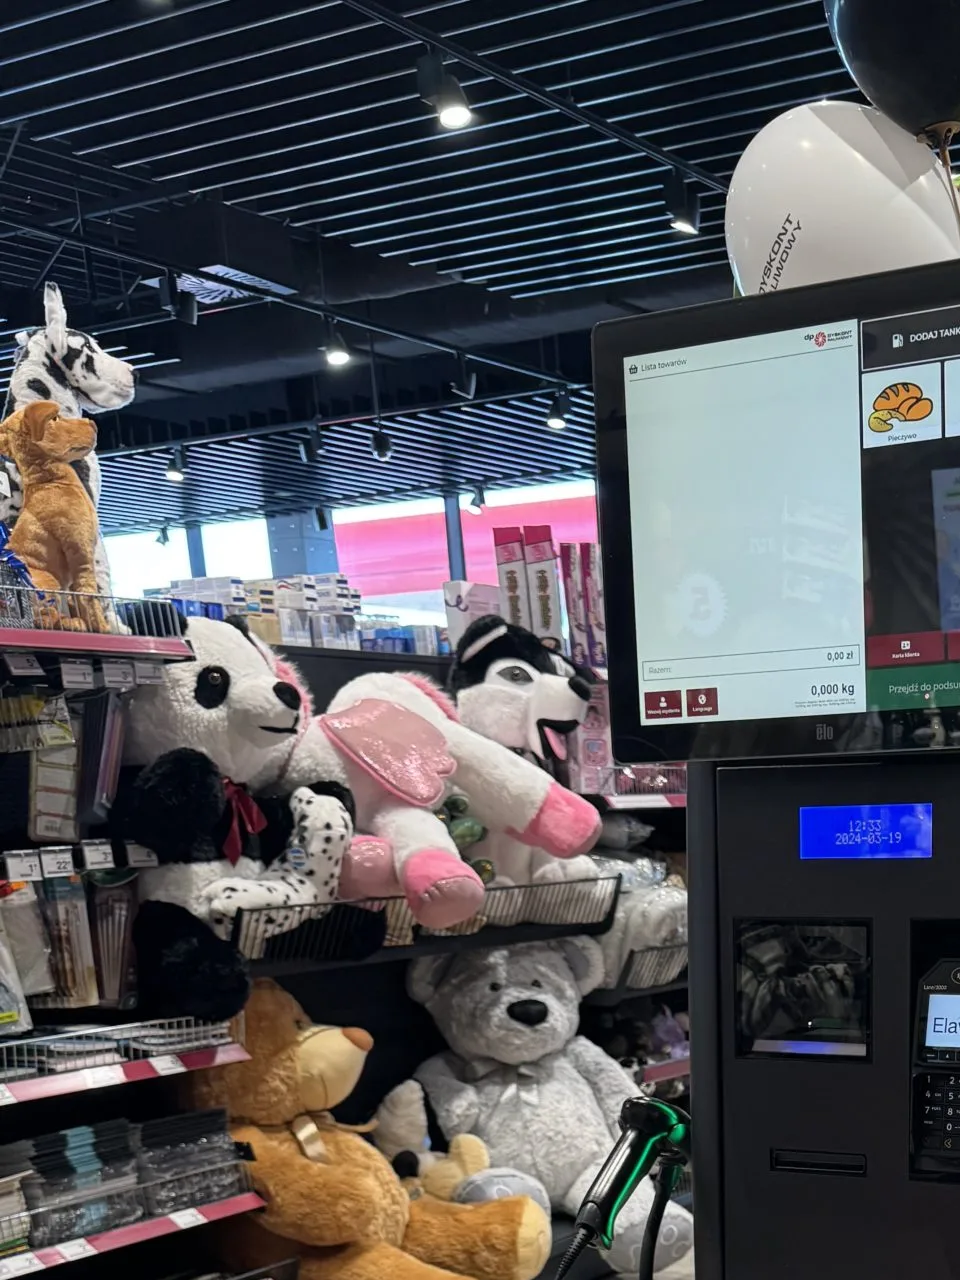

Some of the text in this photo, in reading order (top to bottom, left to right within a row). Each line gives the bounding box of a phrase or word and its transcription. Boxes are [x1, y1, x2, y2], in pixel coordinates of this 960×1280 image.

[770, 219, 802, 291] LIWOWY
[909, 330, 938, 343] DODAJ
[641, 359, 688, 372] Lista towarów
[887, 432, 918, 443] Pieczywo
[827, 651, 854, 662] 0,00 zł
[811, 683, 855, 697] 0,000 kg
[888, 682, 919, 694] Przejdź
[920, 682, 932, 691] do
[849, 819, 881, 832] 12:33
[835, 832, 902, 845] 2024-03-19
[949, 1076, 955, 1084] 2
[948, 1092, 954, 1100] 5
[947, 1107, 953, 1116] 8
